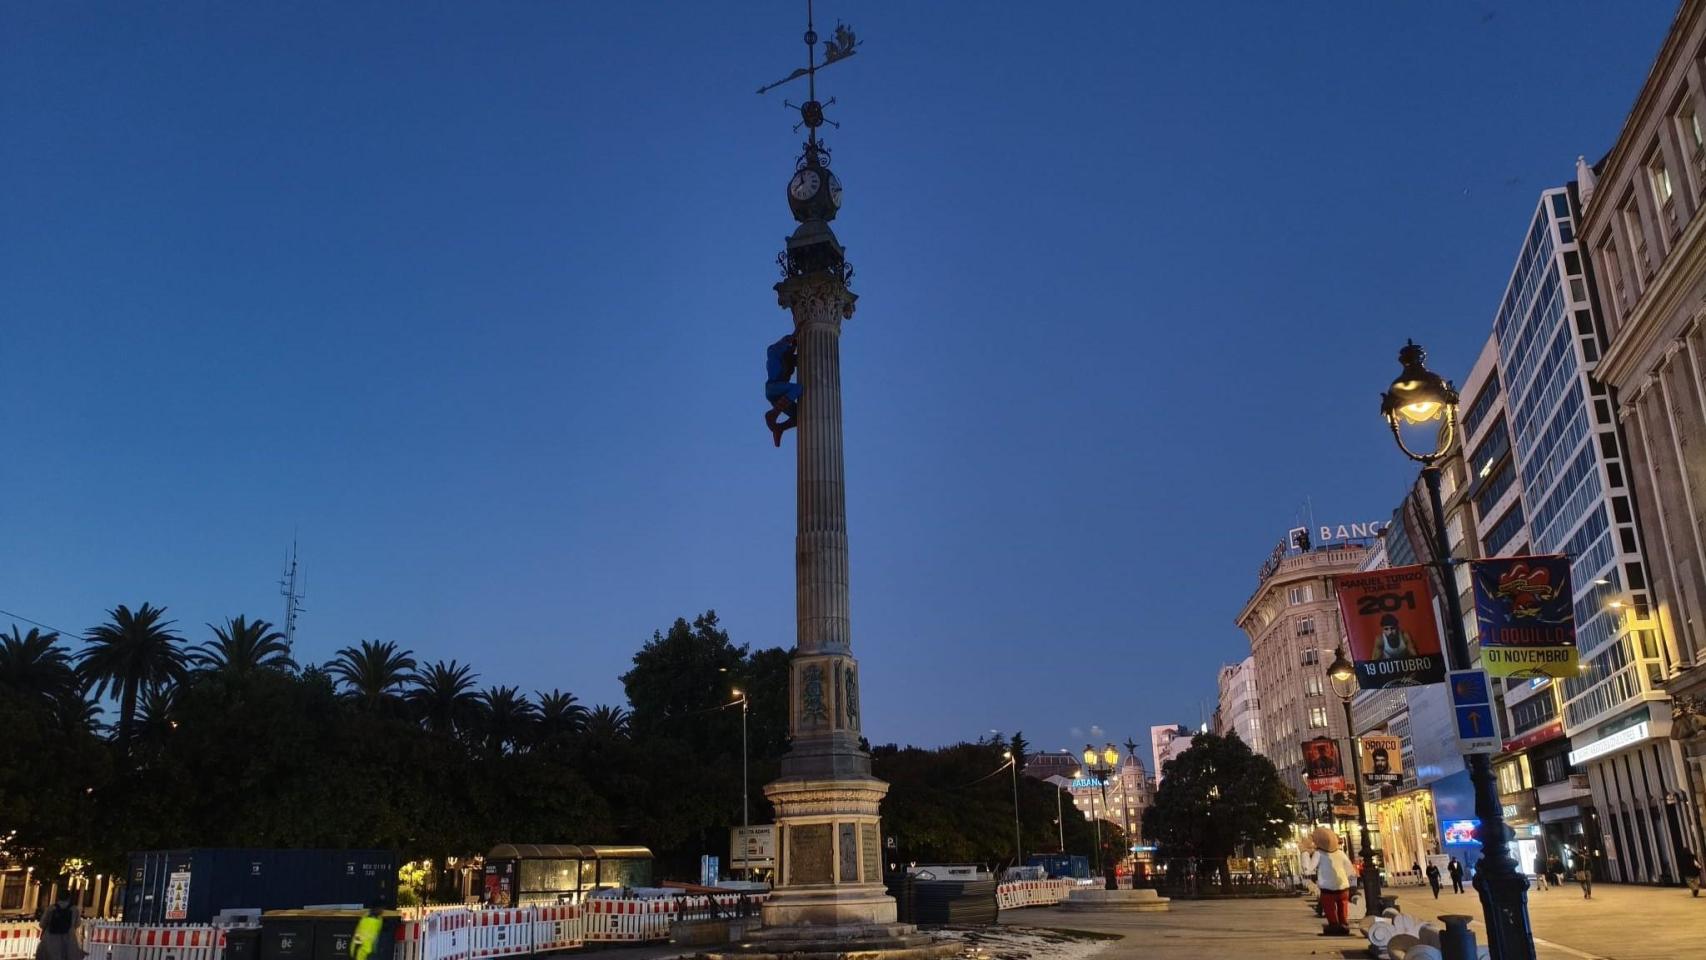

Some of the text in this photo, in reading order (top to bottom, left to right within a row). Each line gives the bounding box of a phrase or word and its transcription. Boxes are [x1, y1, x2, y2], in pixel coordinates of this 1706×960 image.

[1340, 575, 1380, 588] MANUEL
[1385, 571, 1423, 583] TURIZO
[1356, 590, 1416, 616] 201
[1491, 626, 1564, 644] LOQUILLO
[1489, 649, 1569, 662] 01 NOVEMBRO
[1364, 656, 1432, 675] 19 OUTUBRO
[1365, 740, 1397, 750] OROZCO
